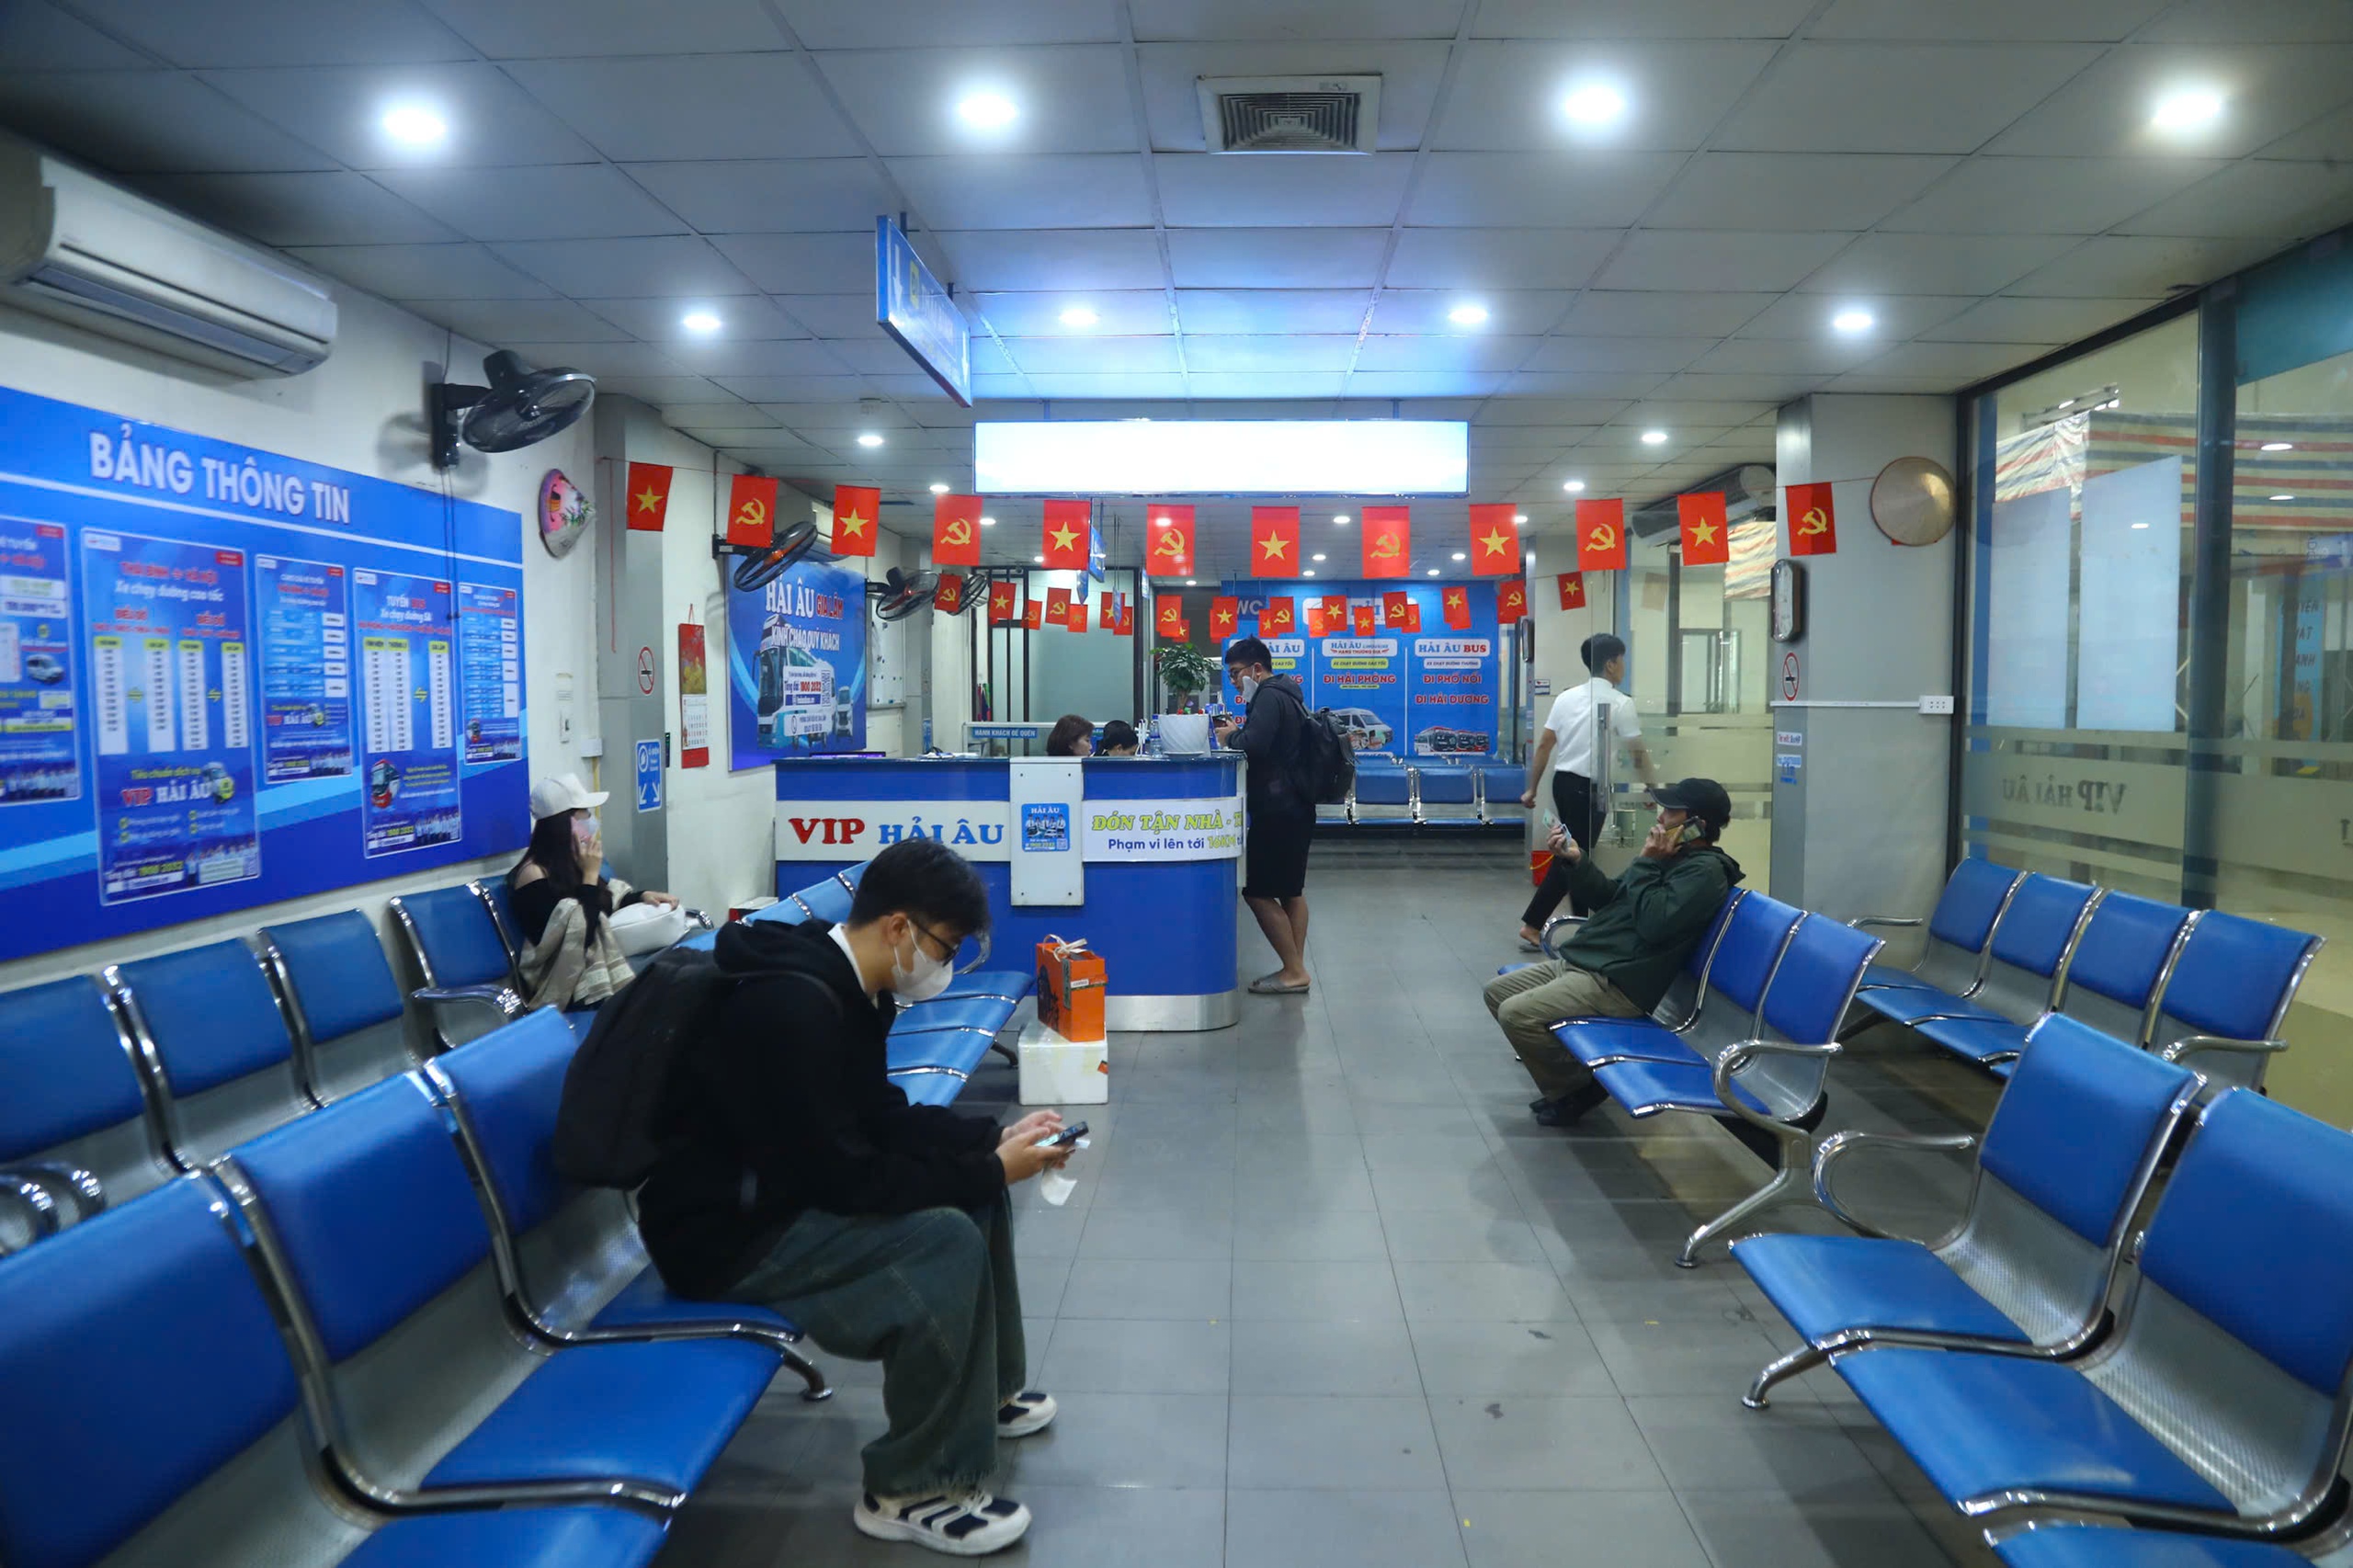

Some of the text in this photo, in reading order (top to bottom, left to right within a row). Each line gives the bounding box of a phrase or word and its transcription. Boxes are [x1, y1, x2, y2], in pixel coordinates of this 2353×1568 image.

[90, 423, 350, 524] BẢNG THÔNG TIN
[386, 594, 410, 608] TUYẾN
[766, 574, 844, 620] HẢI ÂU GIA LÂM
[1237, 599, 1264, 616] WC
[772, 621, 788, 647] KÍNH
[789, 625, 806, 649] CHÀO
[820, 630, 840, 652] KHÁCH
[1269, 641, 1301, 653] ẢI ÂU
[1331, 641, 1347, 649] HẢI
[1348, 641, 1361, 649] ÂU
[1418, 642, 1487, 653] HẢI ÂU BUS
[1324, 672, 1396, 684] ĐI HẢI PHÒNG
[1424, 671, 1482, 684] ĐI PHỐ NỐI
[1415, 692, 1489, 704] ĐI HẢI DƯƠNG
[121, 779, 213, 808] VIP HẢI ÂU
[1031, 805, 1060, 814] HẢI ÂU
[1092, 810, 1135, 831] ĐÓN
[1140, 810, 1181, 835] TẬN
[1184, 809, 1223, 830] NHÀ
[789, 816, 1005, 845] VIP HẢI ÂU
[1108, 838, 1145, 853] Phạm
[1149, 838, 1160, 849] vi
[1164, 837, 1184, 849] lên
[1188, 837, 1204, 849] tới
